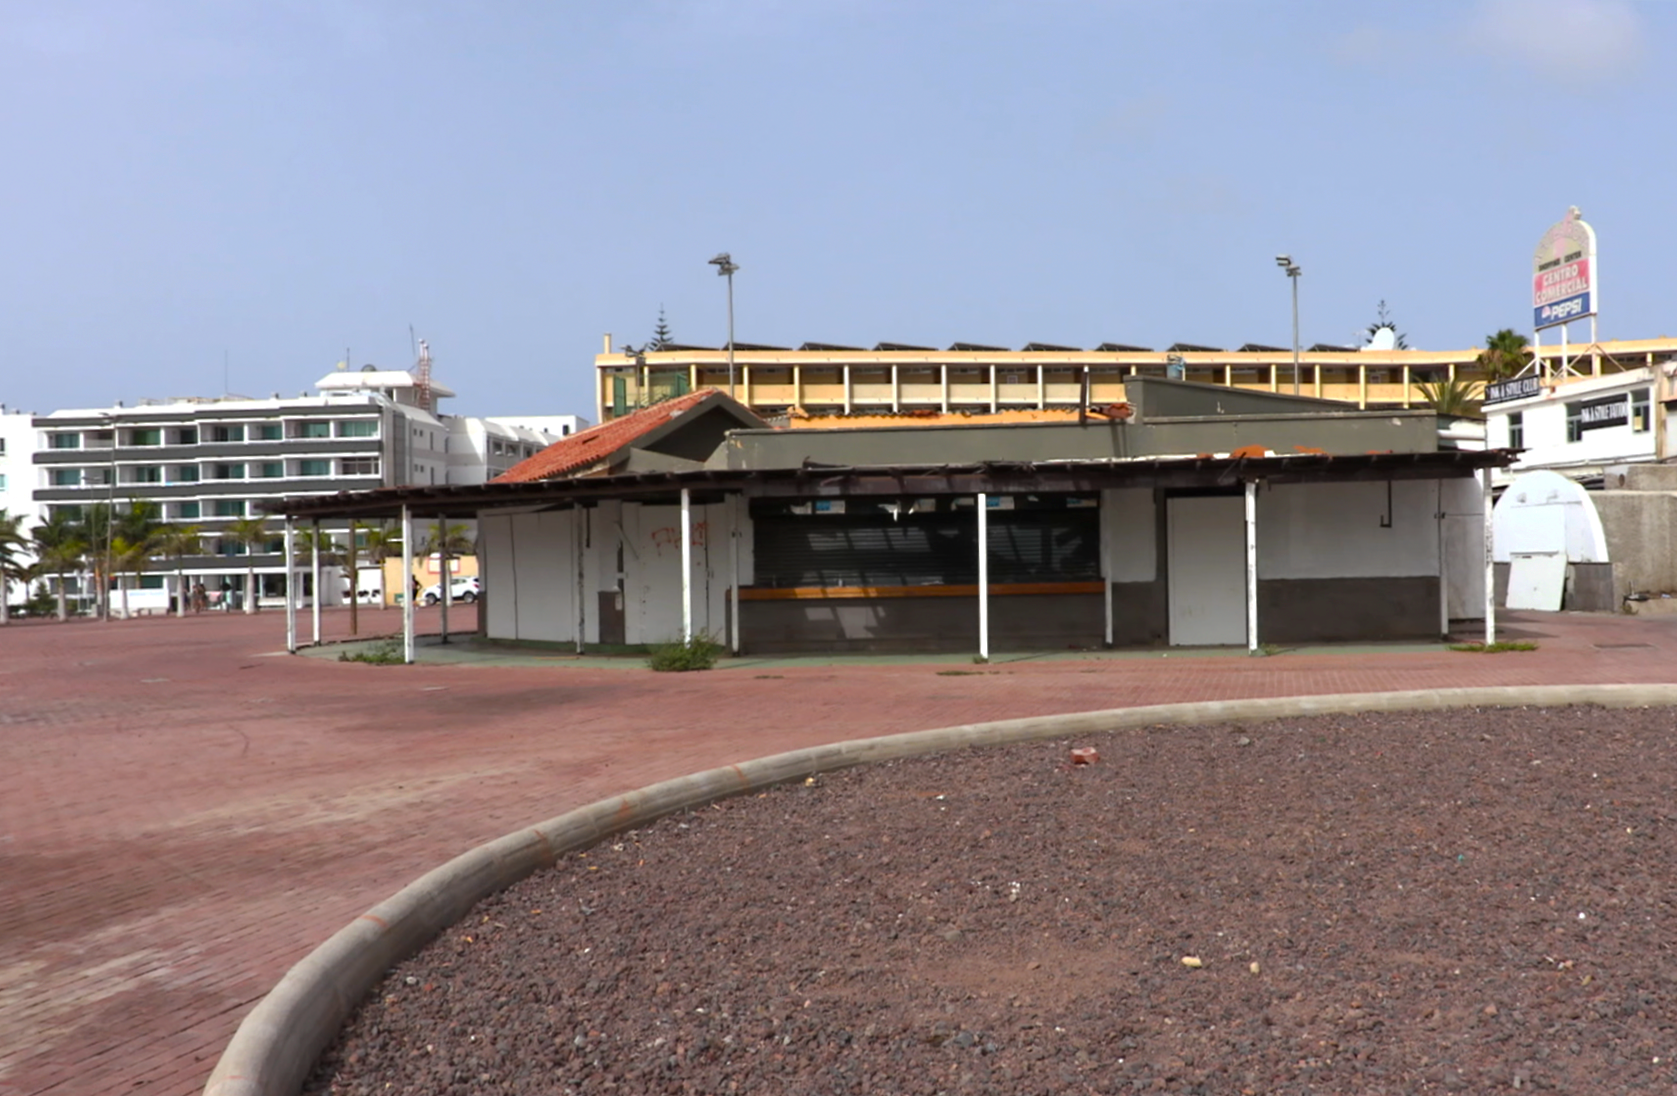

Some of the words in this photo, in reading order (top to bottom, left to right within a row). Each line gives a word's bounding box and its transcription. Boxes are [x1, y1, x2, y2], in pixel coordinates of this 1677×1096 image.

[1543, 264, 1579, 287] CENTRO
[1535, 277, 1588, 303] COMERCIAL
[1550, 297, 1582, 320] PEPSI
